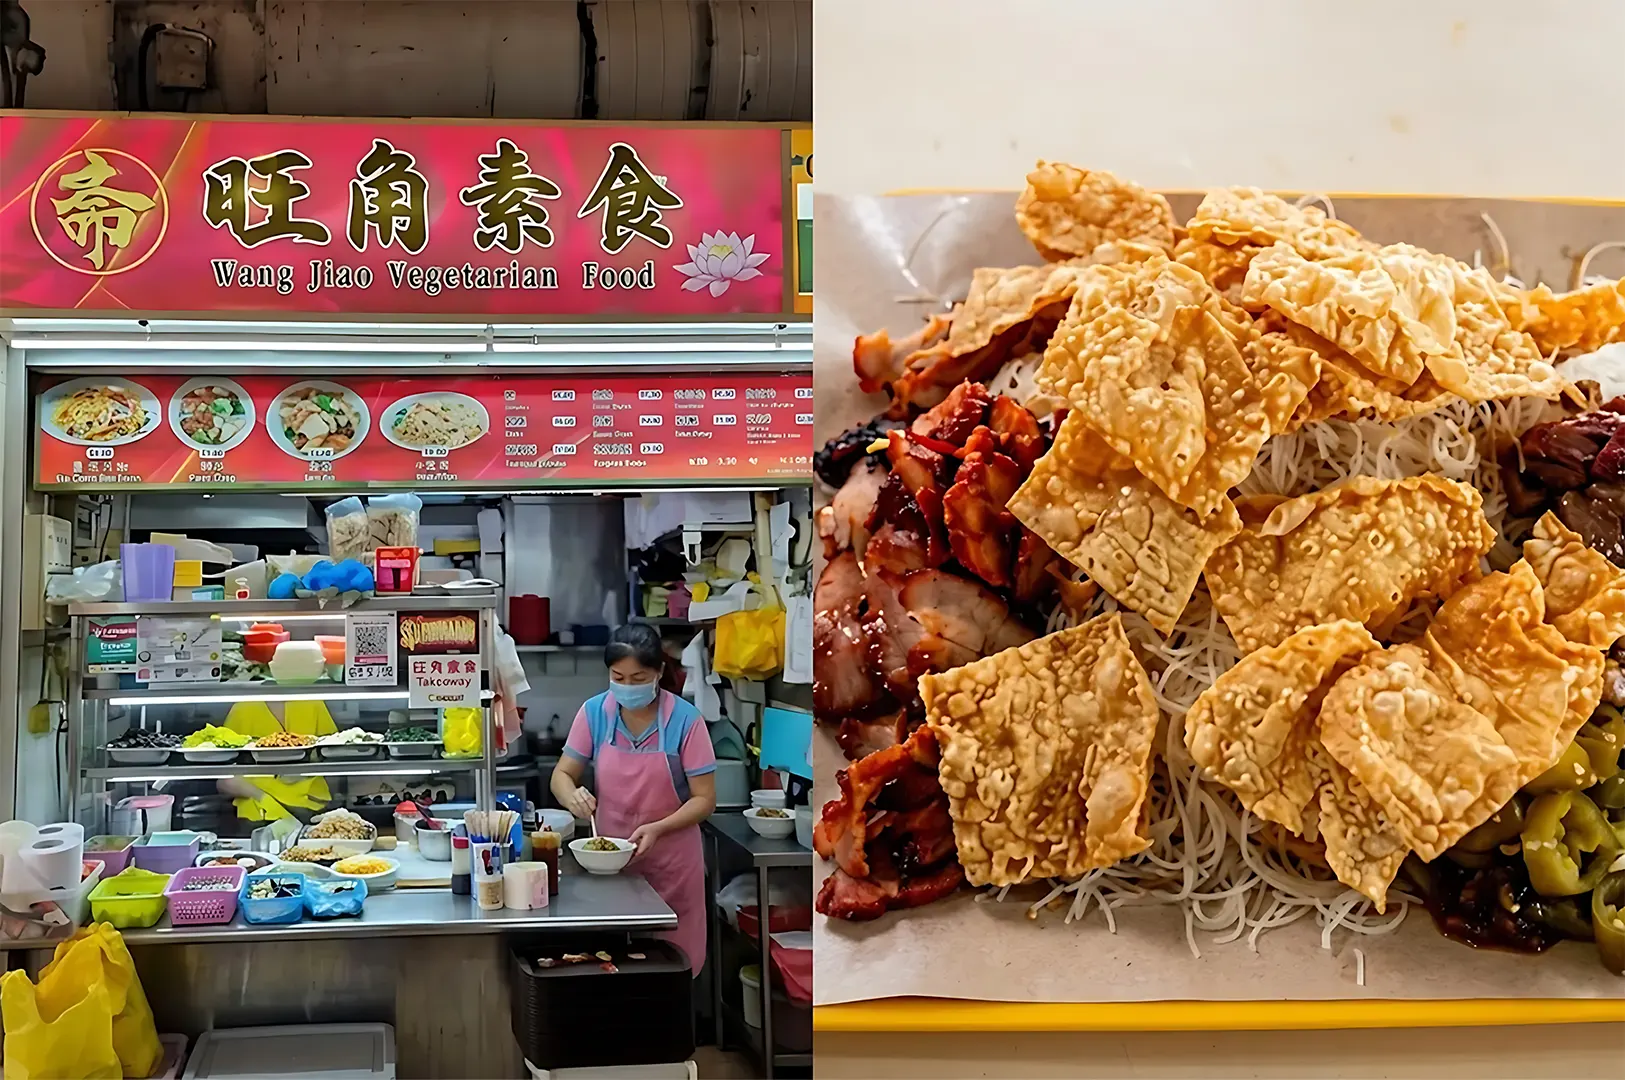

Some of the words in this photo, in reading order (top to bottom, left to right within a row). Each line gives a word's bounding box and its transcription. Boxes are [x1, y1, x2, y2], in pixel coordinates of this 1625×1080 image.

[203, 138, 684, 254] 旺角素食
[211, 259, 294, 295] Wang
[307, 259, 373, 293] Jiao
[387, 259, 559, 295] Vegetarian
[582, 260, 655, 289] Food
